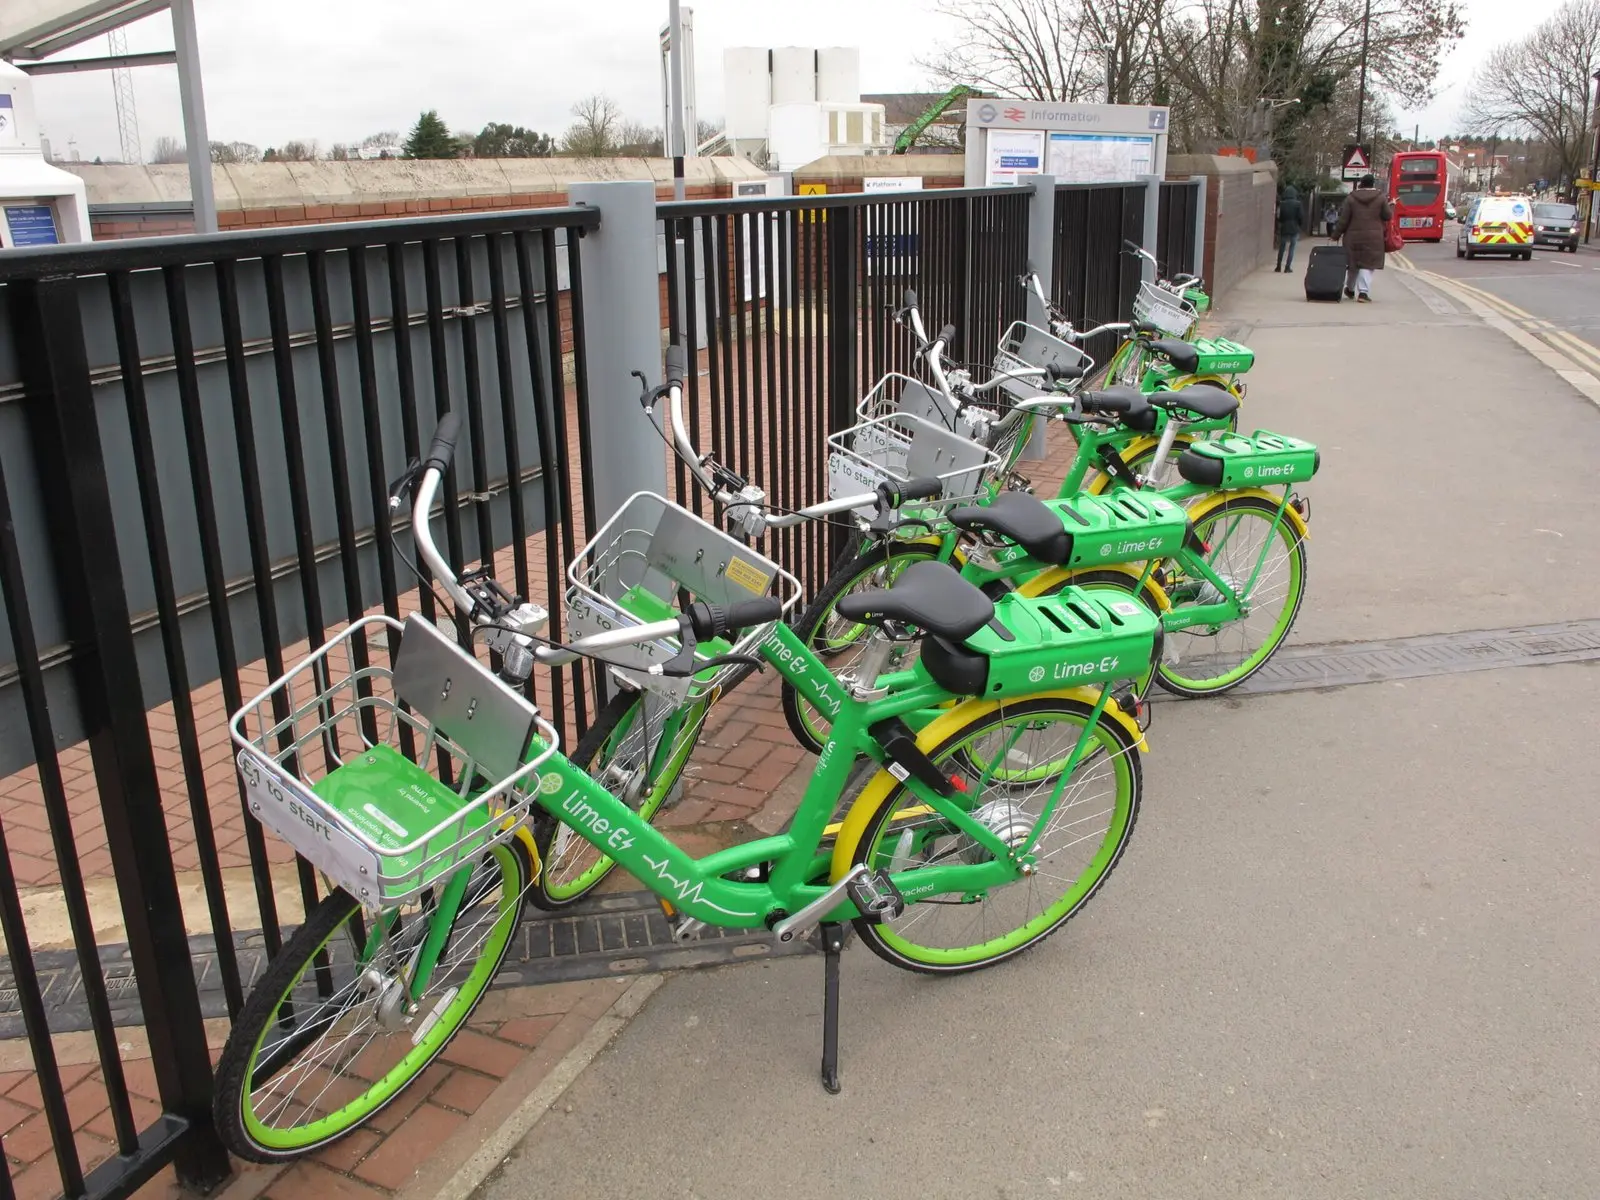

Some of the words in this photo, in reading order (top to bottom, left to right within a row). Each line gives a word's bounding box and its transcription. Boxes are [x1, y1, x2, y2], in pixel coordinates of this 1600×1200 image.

[1031, 108, 1100, 123] Information
[860, 427, 872, 439] £1
[875, 435, 885, 446] to
[830, 455, 840, 470] £1
[843, 463, 852, 476] to
[854, 471, 876, 489] start
[572, 600, 591, 617] £1
[596, 613, 612, 630] to
[1168, 617, 1191, 626] Tracked
[242, 758, 261, 782] £1
[265, 778, 284, 803] to
[289, 800, 332, 842] start
[411, 784, 429, 798] Lime
[348, 807, 384, 837] experience
